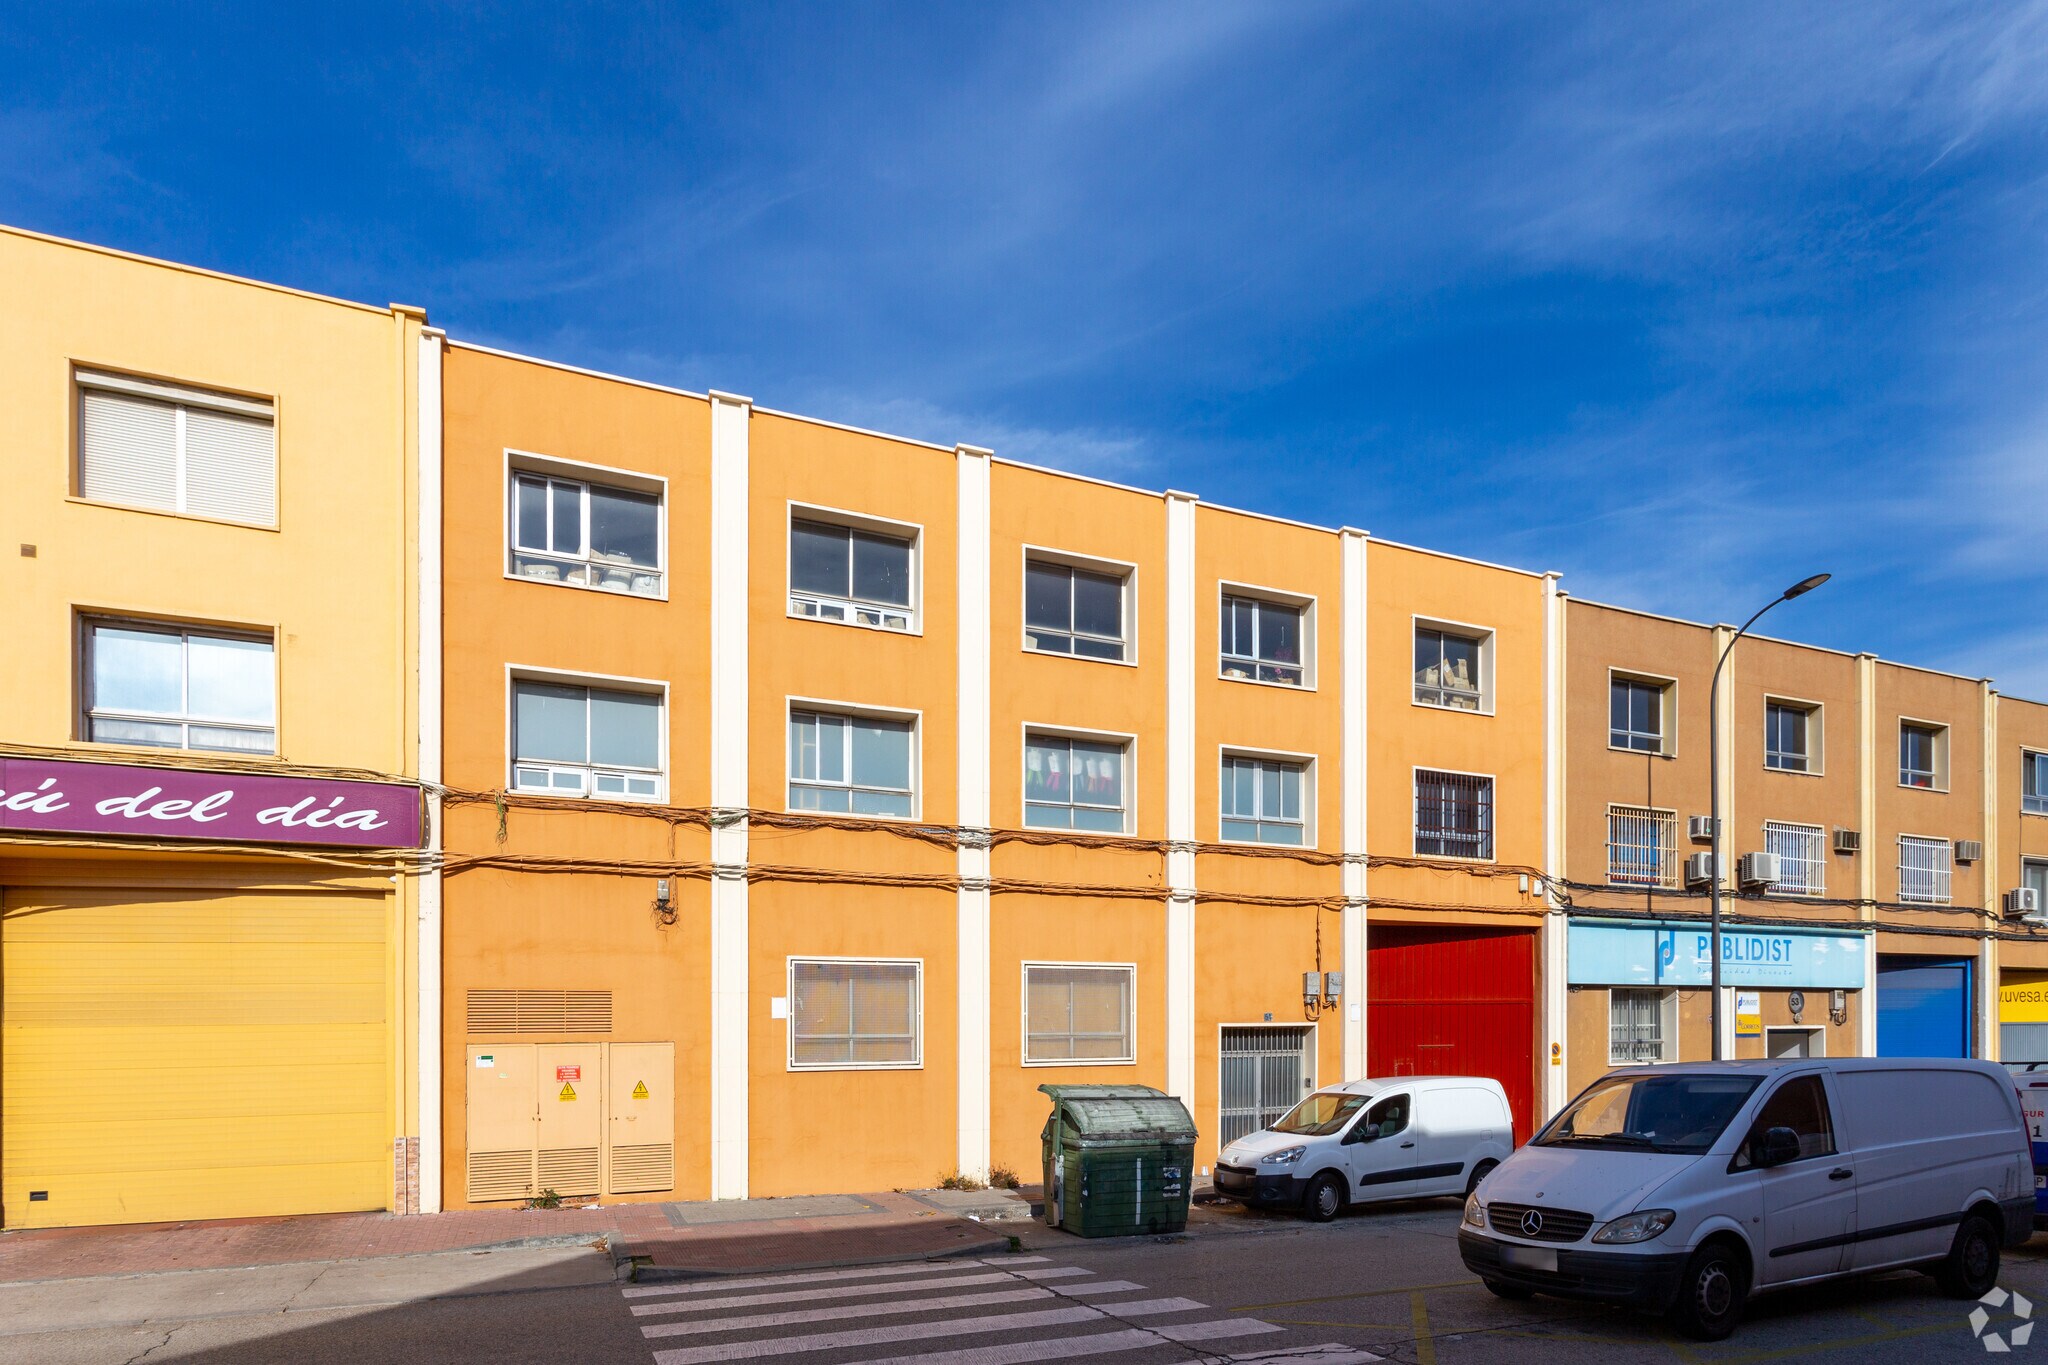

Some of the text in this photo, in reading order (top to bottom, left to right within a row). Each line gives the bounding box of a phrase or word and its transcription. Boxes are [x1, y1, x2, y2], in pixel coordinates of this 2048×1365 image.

[95, 786, 234, 822] del
[255, 796, 389, 831] día
[1697, 935, 1792, 962] PBLIDIST
[1791, 997, 1800, 1006] 53
